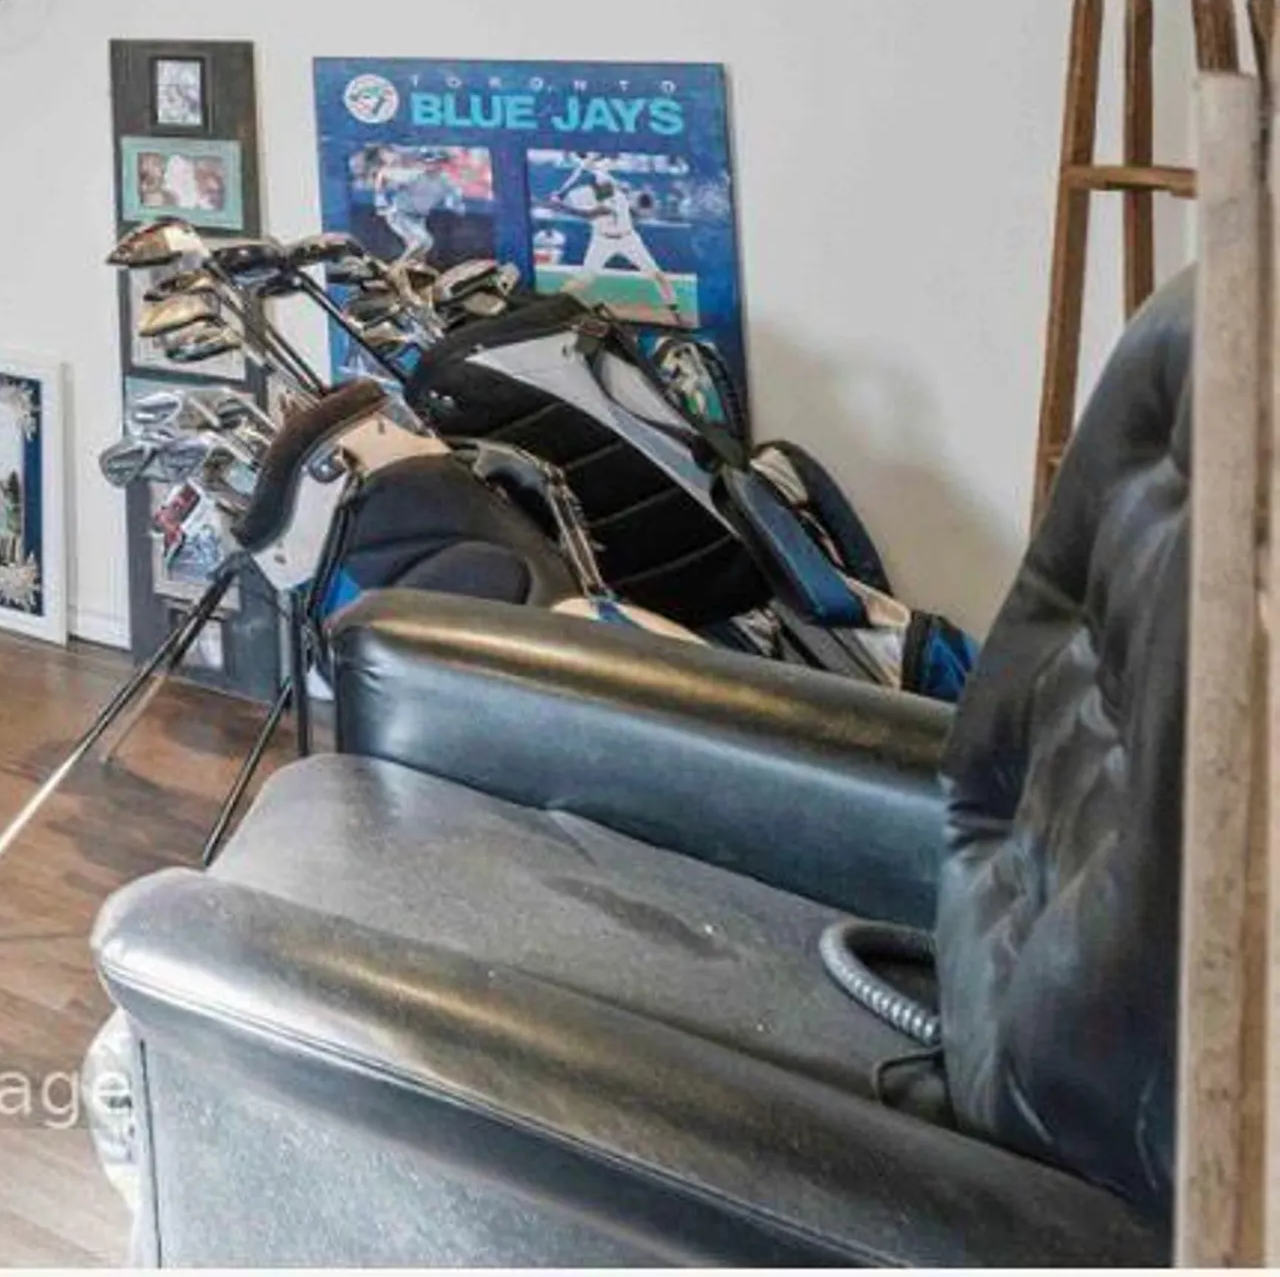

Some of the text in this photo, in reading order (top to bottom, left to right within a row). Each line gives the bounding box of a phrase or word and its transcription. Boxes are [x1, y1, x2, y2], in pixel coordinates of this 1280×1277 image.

[411, 74, 678, 94] TORONTO
[410, 90, 685, 135] BLUE JAYS
